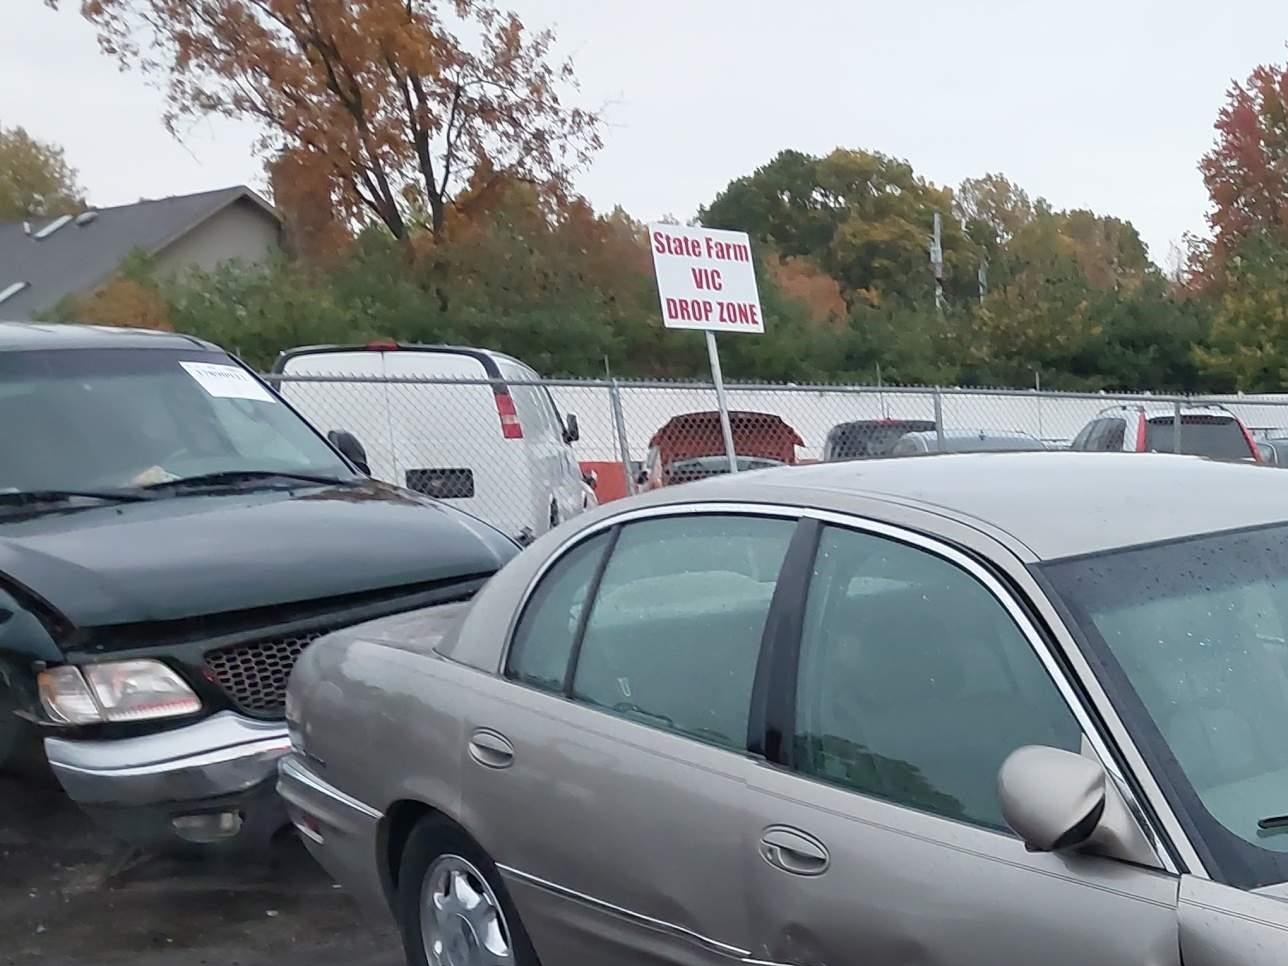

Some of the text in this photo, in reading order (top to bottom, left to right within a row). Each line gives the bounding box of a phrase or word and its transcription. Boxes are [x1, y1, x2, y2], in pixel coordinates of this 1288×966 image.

[653, 231, 749, 262] State Farm
[691, 267, 722, 291] VIC
[666, 297, 759, 325] DROP ZONE
